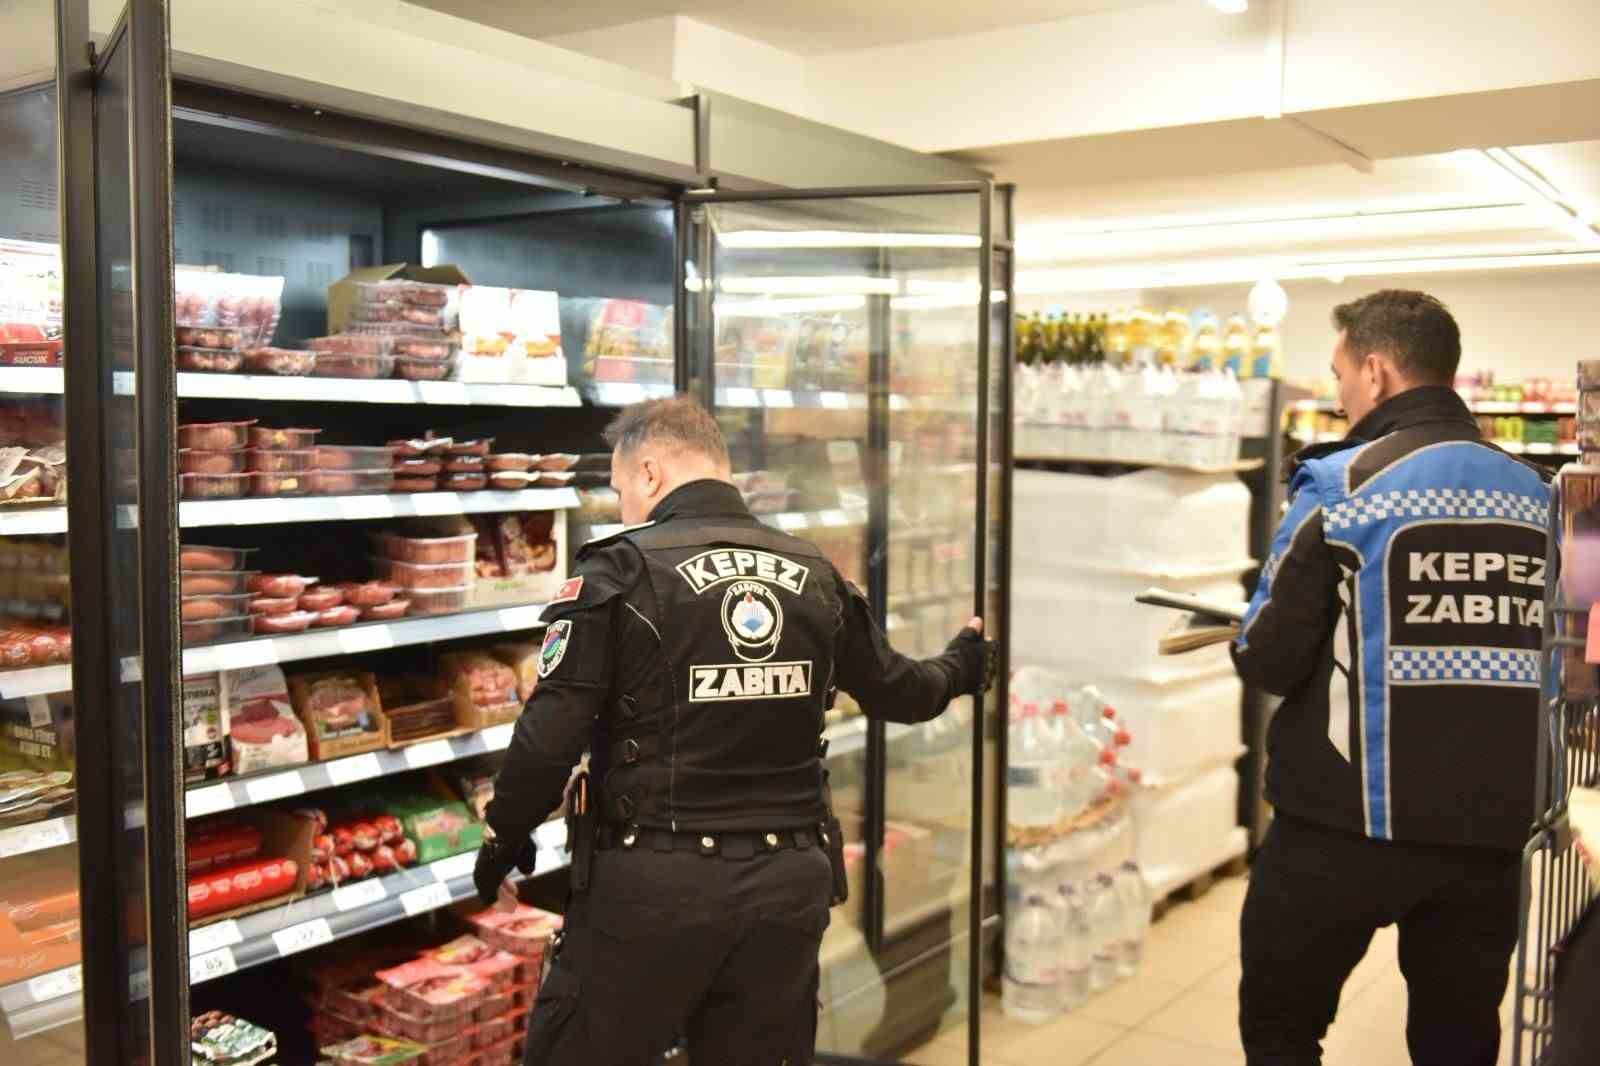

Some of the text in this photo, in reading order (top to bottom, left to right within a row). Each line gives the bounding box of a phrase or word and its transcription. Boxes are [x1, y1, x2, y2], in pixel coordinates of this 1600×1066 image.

[685, 551, 801, 588] KEPEZ
[1408, 552, 1546, 586] KEPEZ
[1405, 594, 1545, 628] ZABITA
[694, 665, 808, 698] ZABITA
